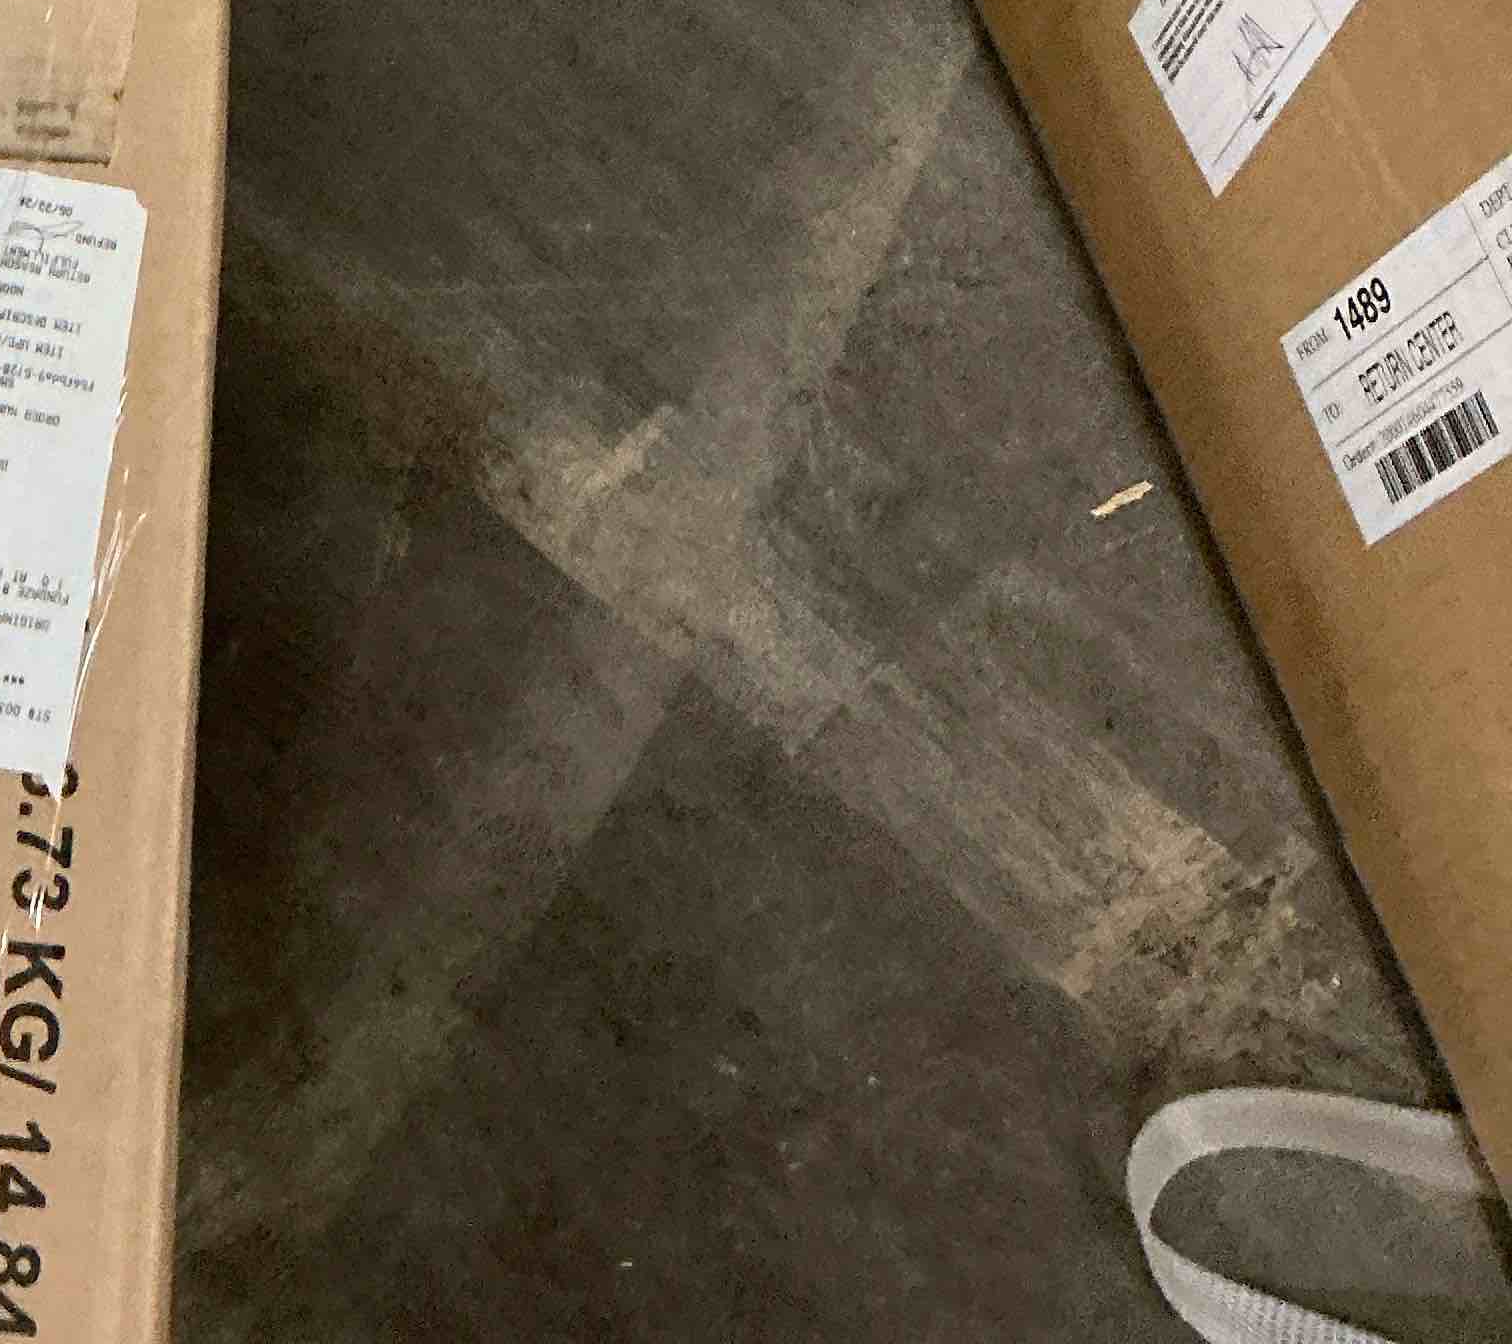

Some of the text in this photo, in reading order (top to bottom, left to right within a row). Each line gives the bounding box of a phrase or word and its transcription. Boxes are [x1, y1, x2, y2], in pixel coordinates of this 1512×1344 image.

[1333, 276, 1392, 342] 1489
[1358, 344, 1413, 407] RETURN
[1407, 309, 1464, 374] CENTER
